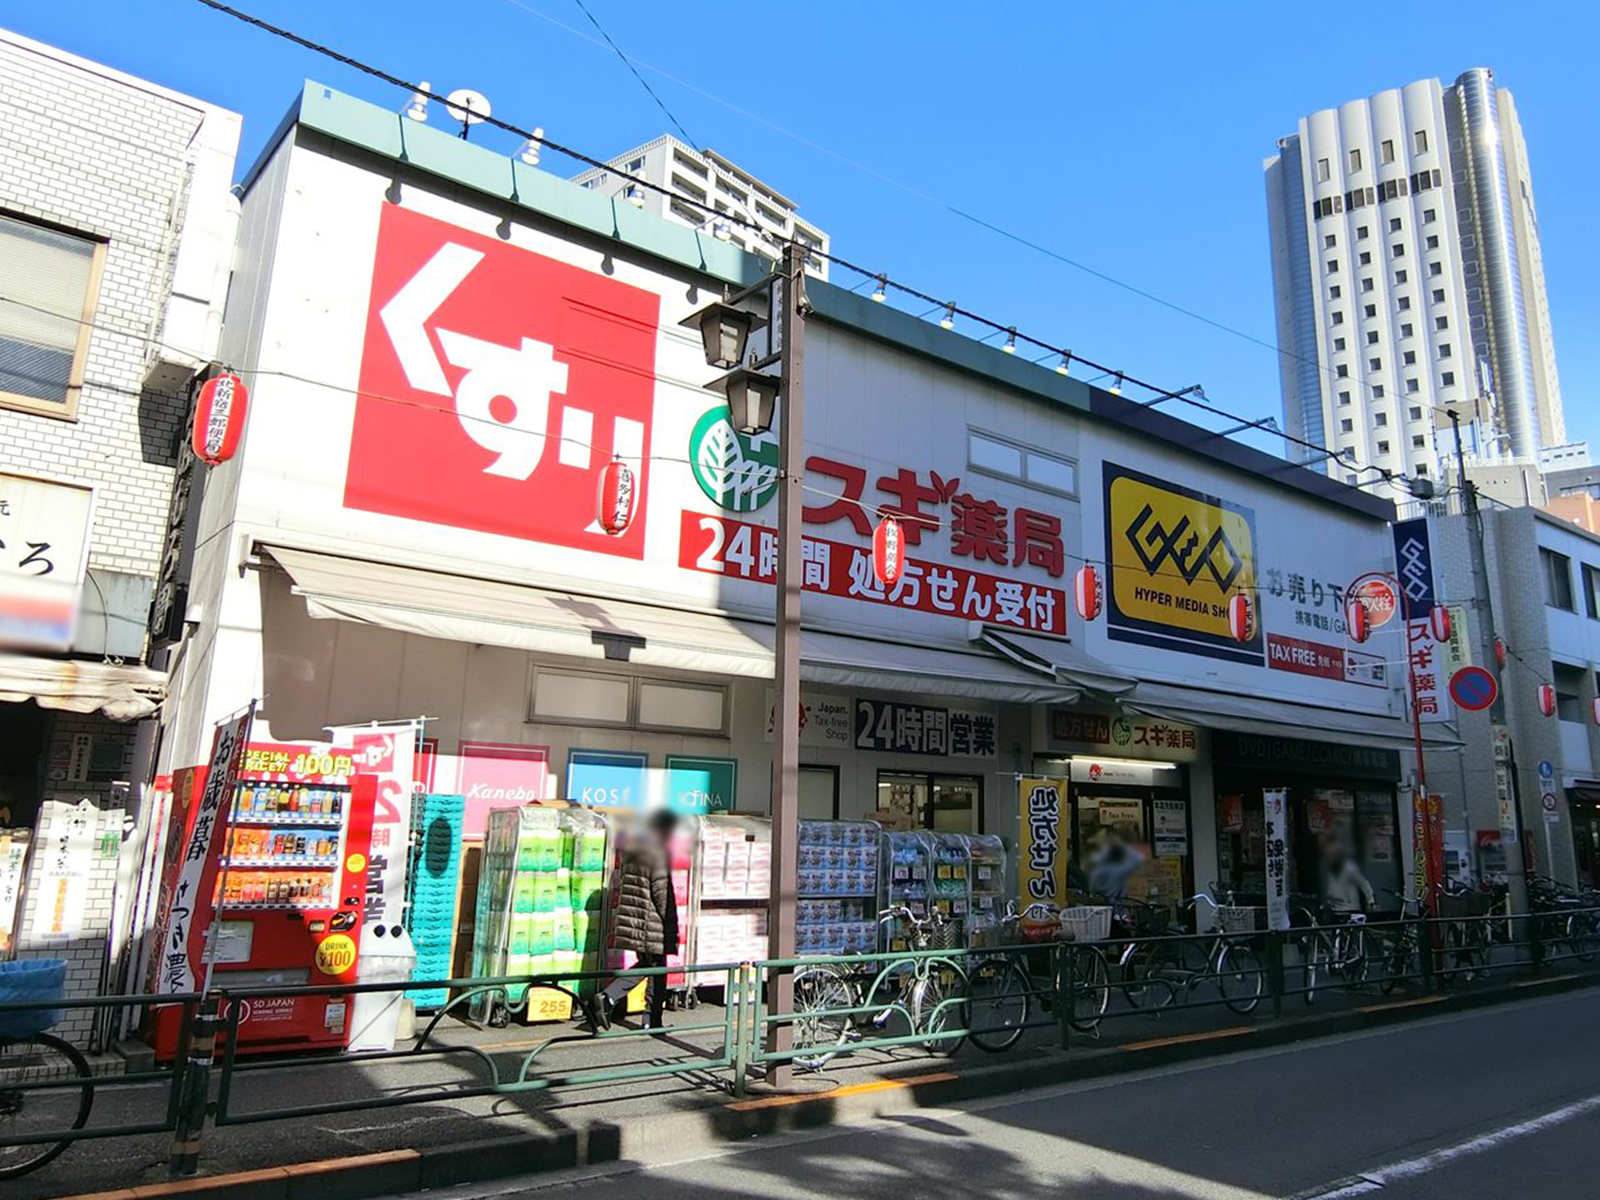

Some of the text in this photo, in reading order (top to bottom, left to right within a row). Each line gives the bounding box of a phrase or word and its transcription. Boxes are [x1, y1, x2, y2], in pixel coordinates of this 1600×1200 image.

[379, 241, 645, 538] くすり
[802, 455, 1064, 577] スギ薬局
[1125, 503, 1243, 595] GEO
[1400, 537, 1429, 602] GEO
[849, 550, 1056, 632] 処方せん受付
[1135, 586, 1173, 607] HYPER
[1175, 597, 1209, 616] MEDIA
[1211, 604, 1230, 619] SH
[1266, 568, 1344, 613] お売り下
[1269, 643, 1291, 663] TAX
[1292, 648, 1316, 667] FREE
[1409, 623, 1439, 715] スギ薬局
[818, 702, 848, 717] Japan.
[813, 715, 848, 729] Tax-free
[856, 702, 996, 757] 24時間営業
[826, 729, 848, 743] Shop
[1133, 725, 1196, 750] スギ薬局
[242, 749, 291, 762] PECIAL
[296, 753, 353, 777] 100円
[467, 783, 535, 801] Kanebo
[324, 941, 349, 952] DRINK
[319, 950, 352, 968] ¥100
[266, 998, 296, 1009] JAPAN
[540, 1001, 567, 1013] 255
